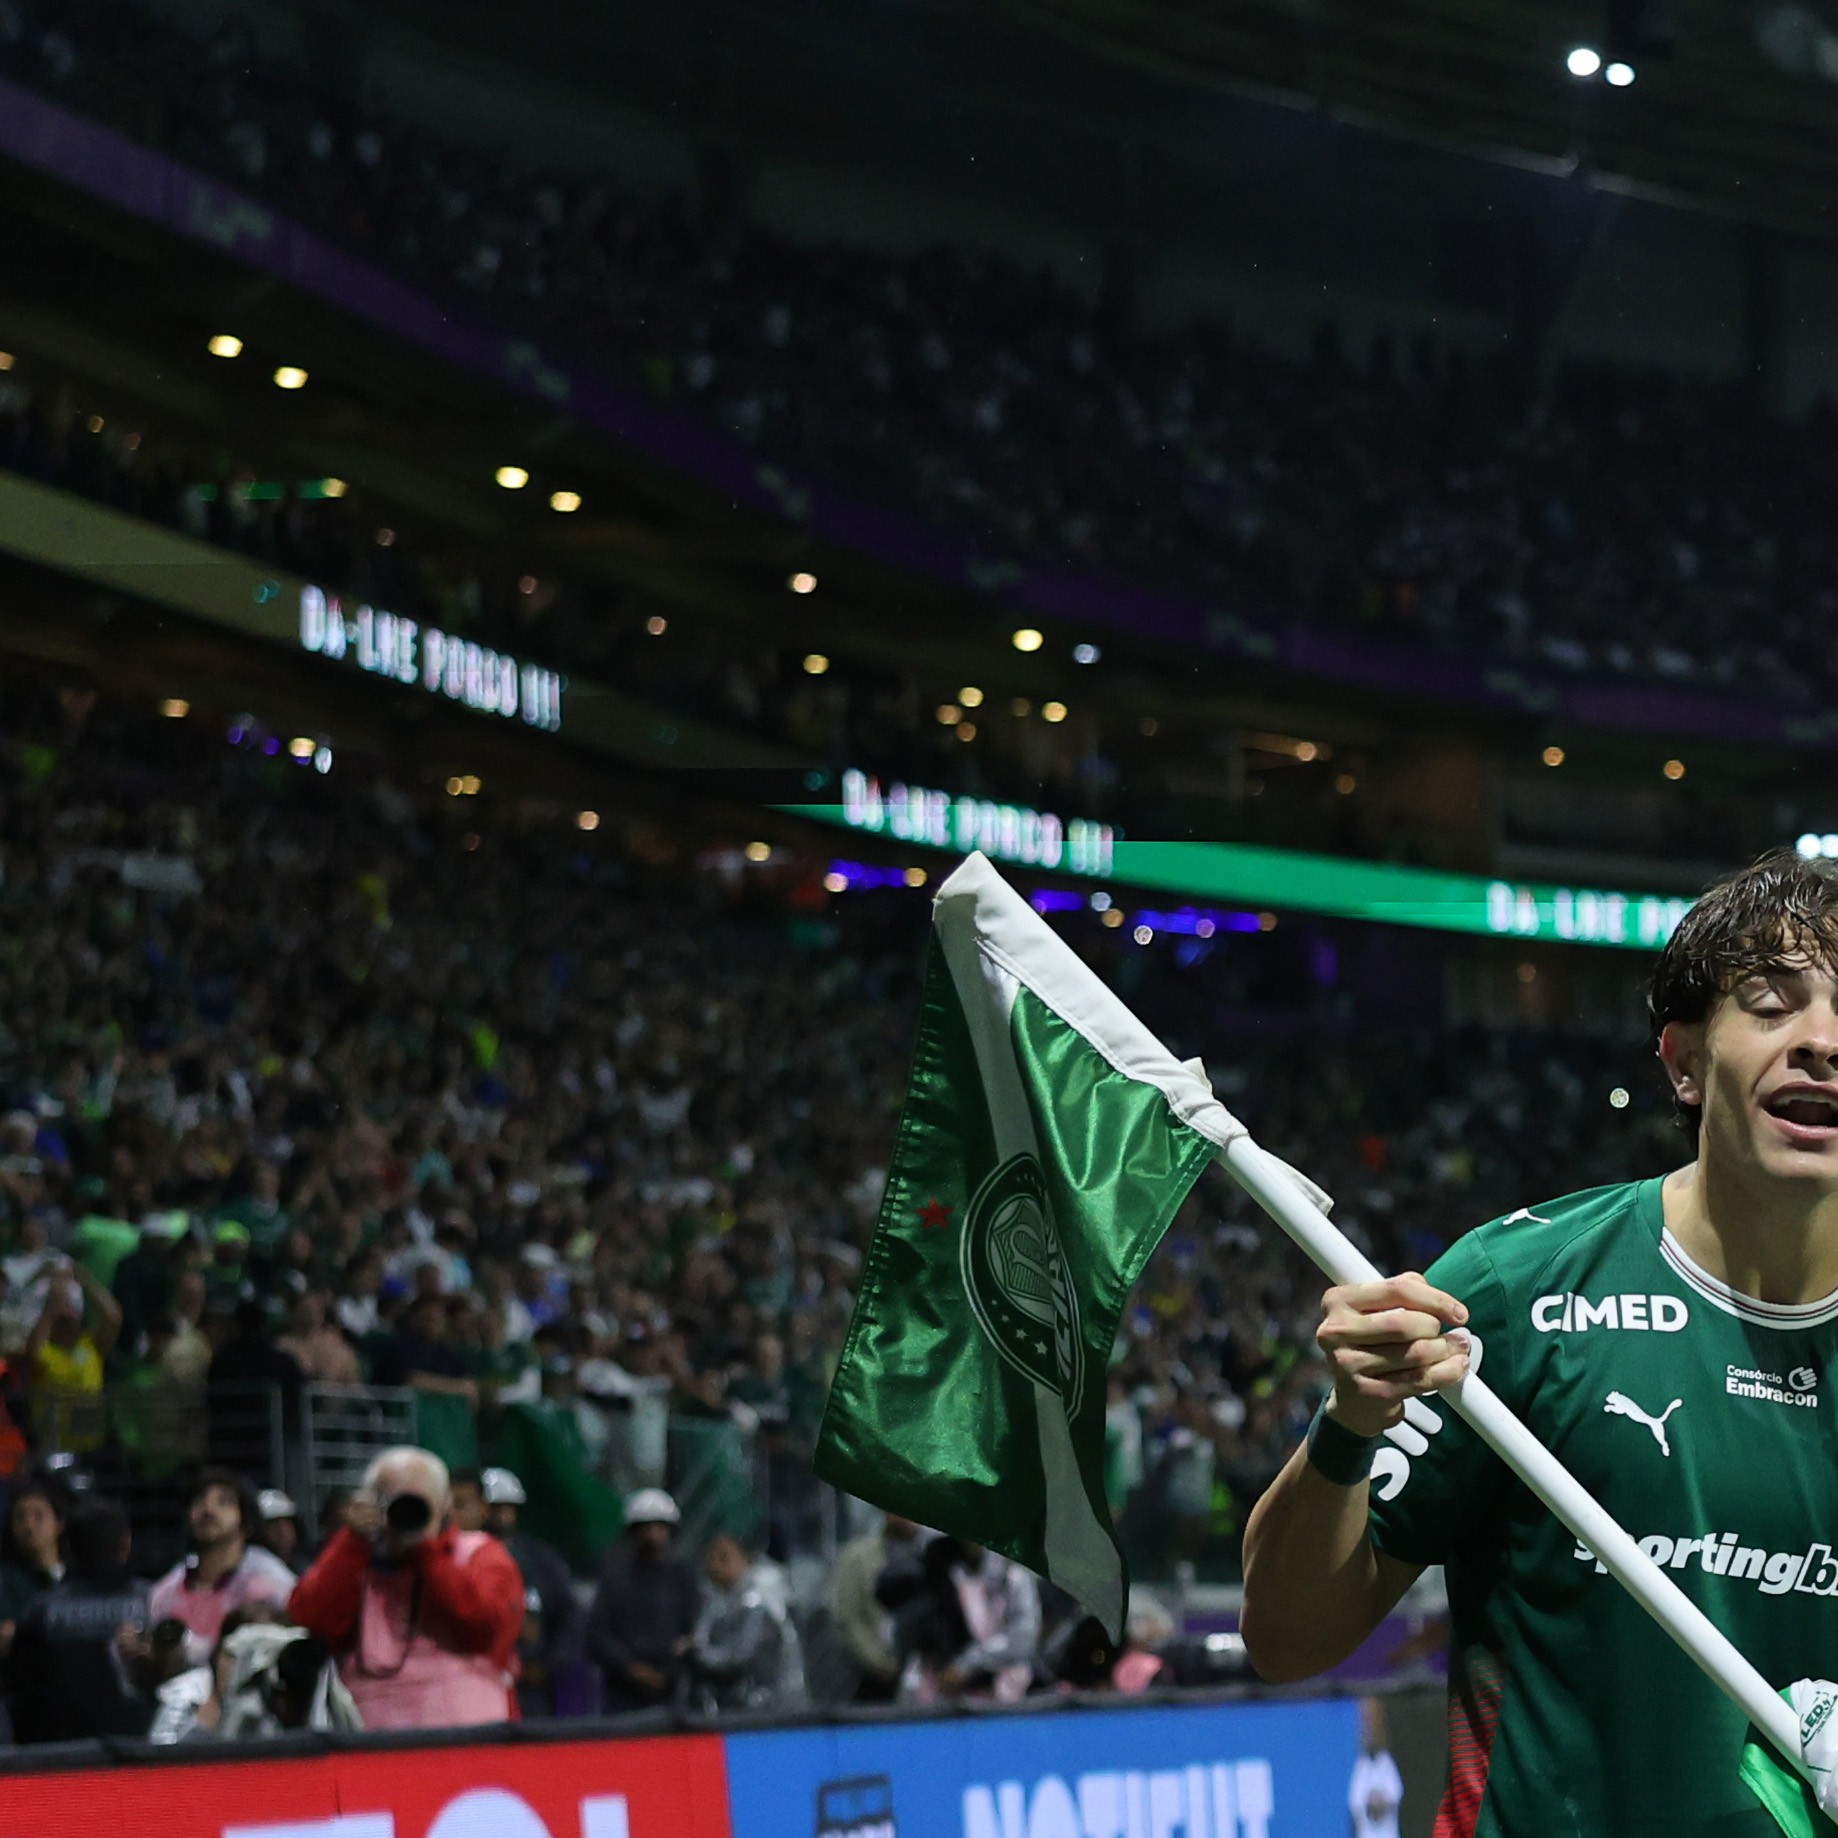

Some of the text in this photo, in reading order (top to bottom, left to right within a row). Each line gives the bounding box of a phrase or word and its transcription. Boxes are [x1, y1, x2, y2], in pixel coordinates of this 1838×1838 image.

[1531, 1292, 1689, 1333] CIMED
[1726, 1364, 1783, 1385] Consórcio
[1725, 1377, 1819, 1408] Embracon
